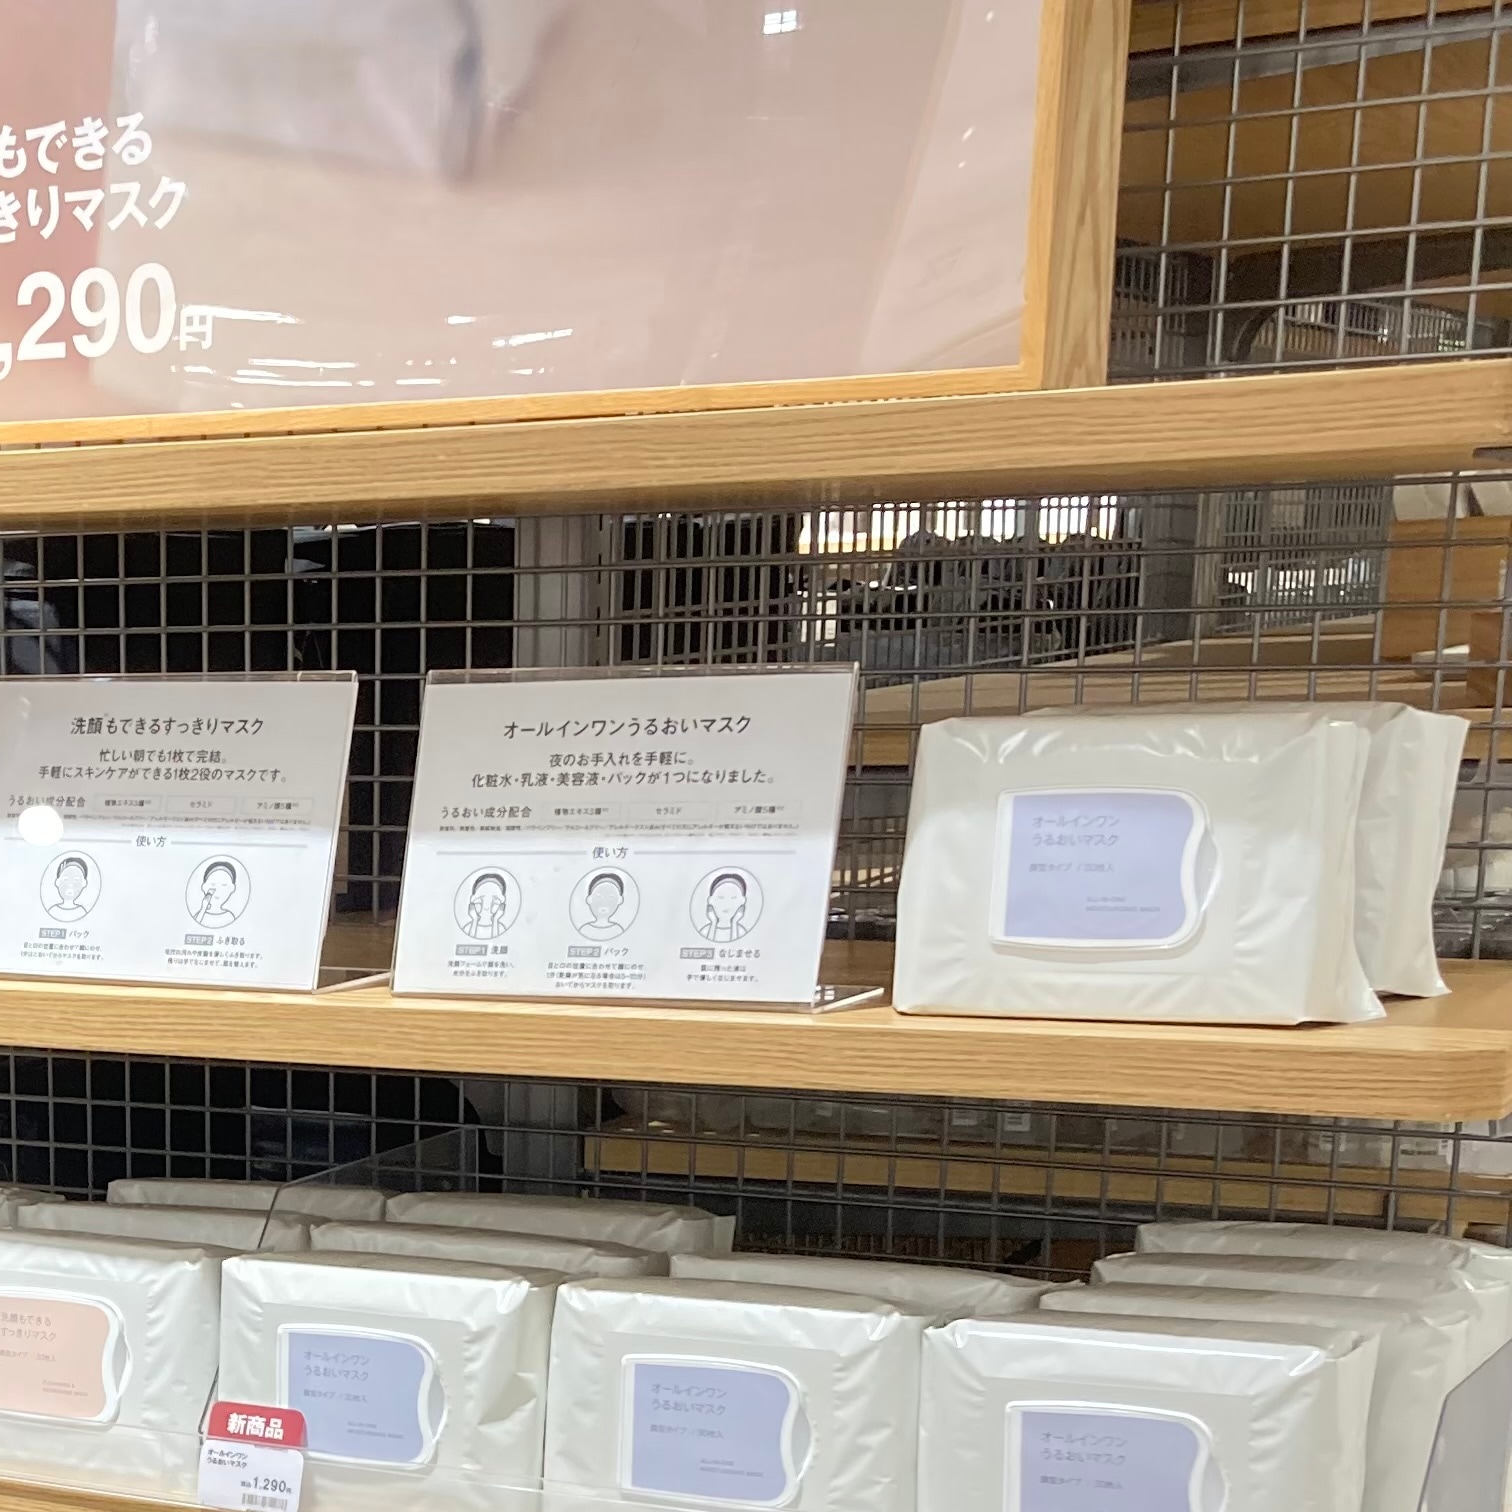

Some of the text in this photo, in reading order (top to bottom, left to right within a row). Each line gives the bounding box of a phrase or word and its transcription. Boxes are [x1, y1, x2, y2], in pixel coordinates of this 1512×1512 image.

[70, 716, 264, 736] 洗顔もできるすっきりマスク
[503, 715, 752, 738] オールインワンうるおいマスク
[549, 750, 695, 768] 夜のお手入れを手軽に。
[136, 835, 167, 848] 使い方
[592, 845, 628, 860] 使い方
[227, 1412, 284, 1440] 新商品
